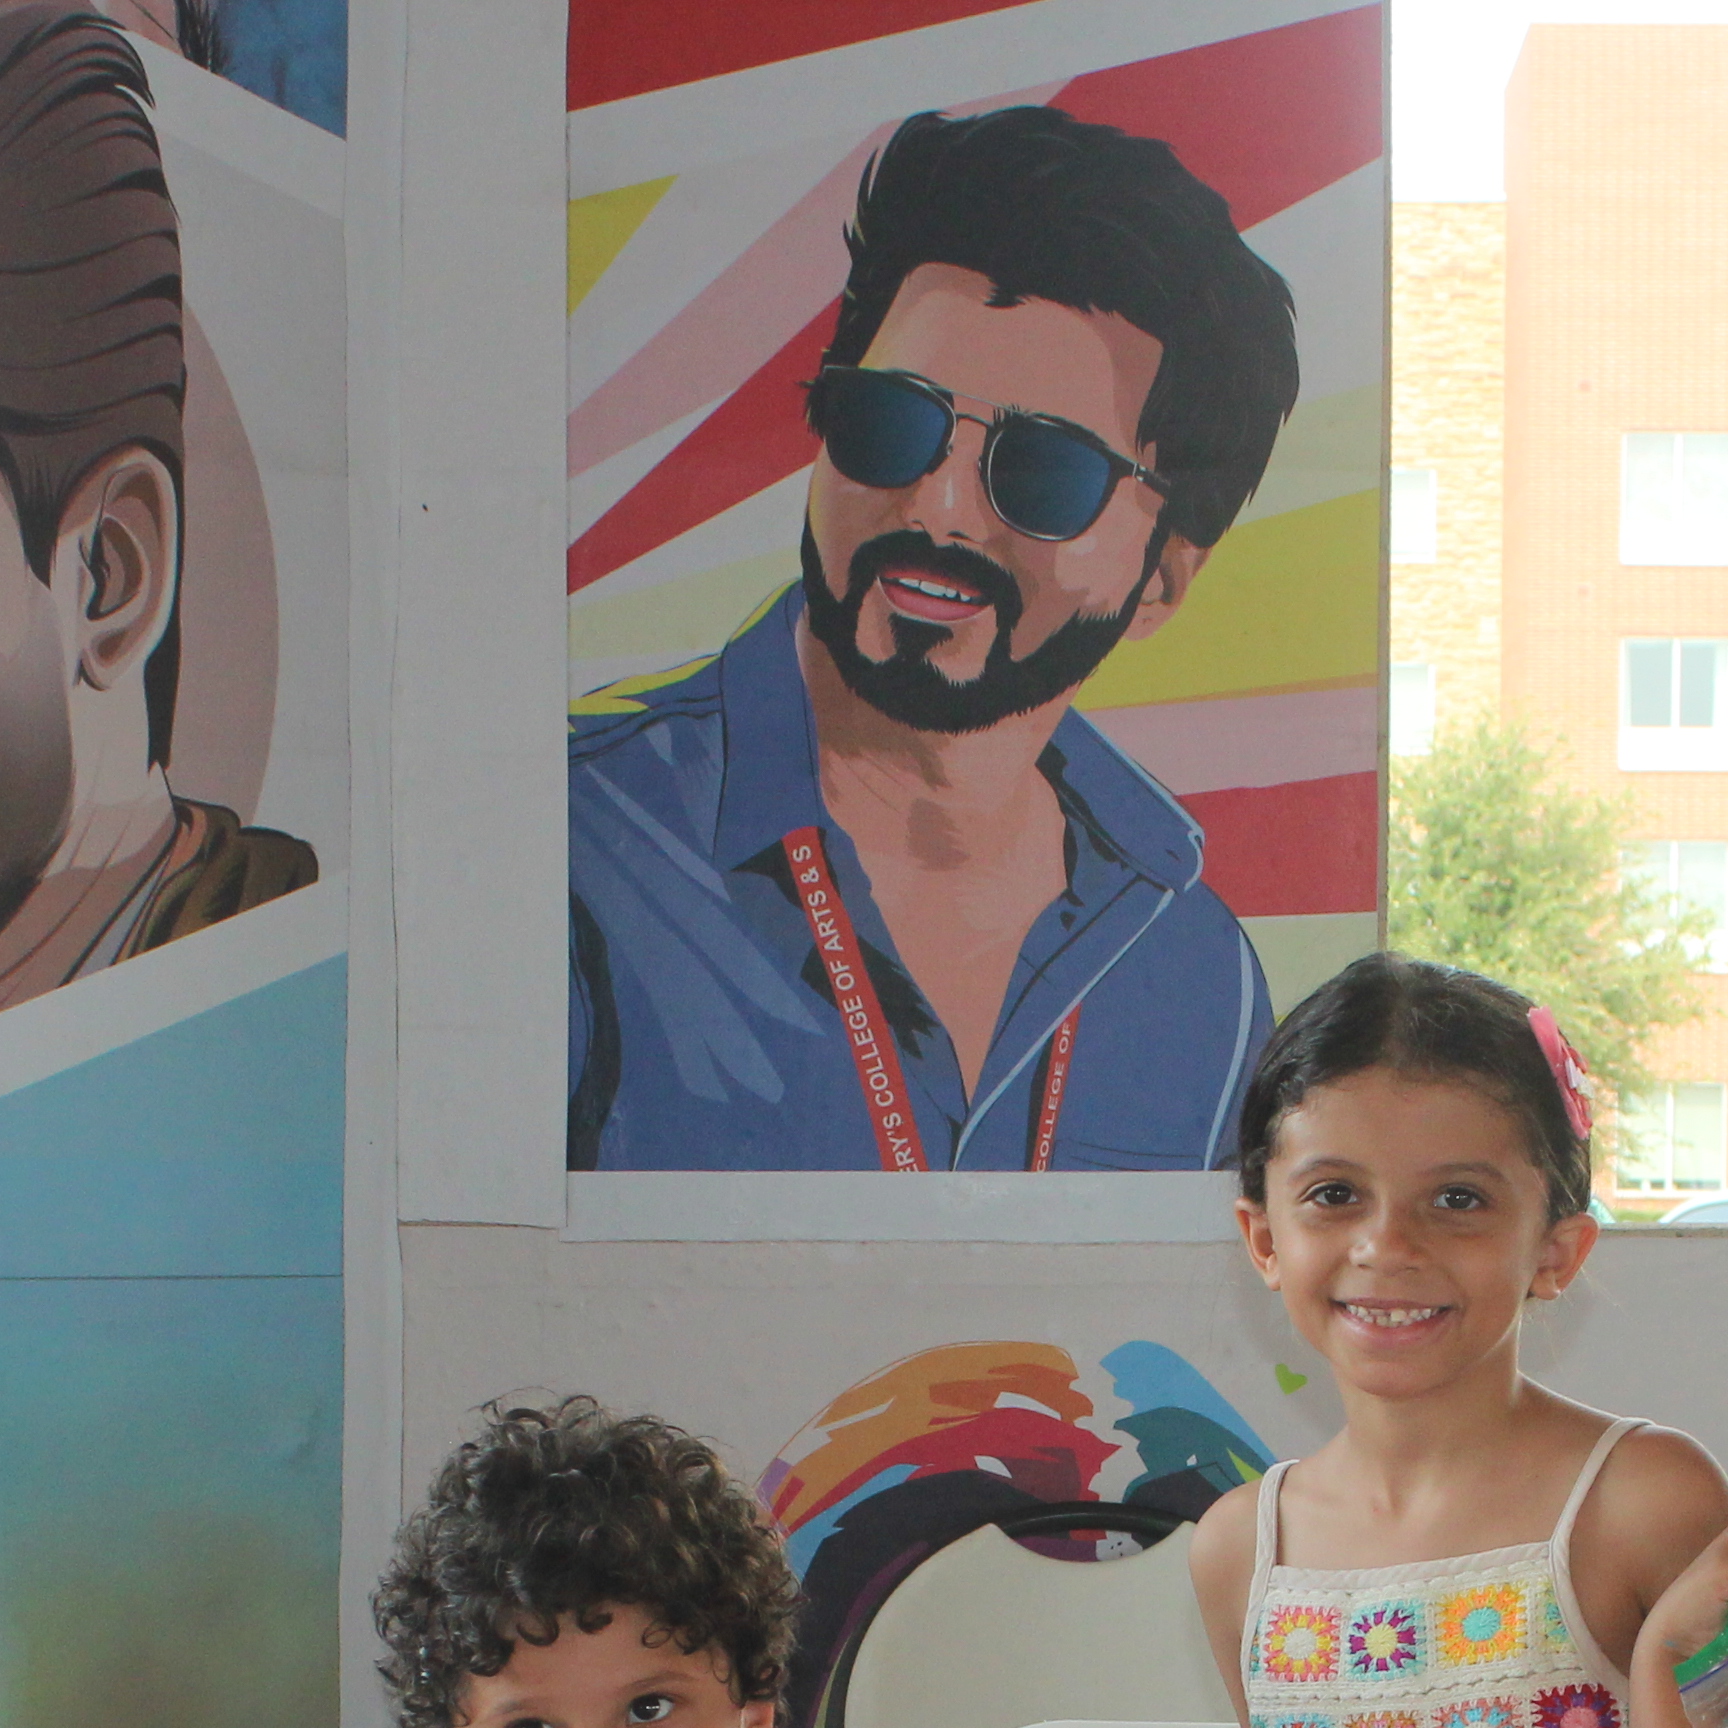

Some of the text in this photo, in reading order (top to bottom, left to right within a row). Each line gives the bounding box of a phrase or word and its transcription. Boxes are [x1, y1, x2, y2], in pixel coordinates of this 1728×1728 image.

[806, 888, 845, 952] ARTS
[829, 956, 856, 991] OF
[843, 996, 895, 1108] COLLEGE
[1058, 1022, 1072, 1054] OF
